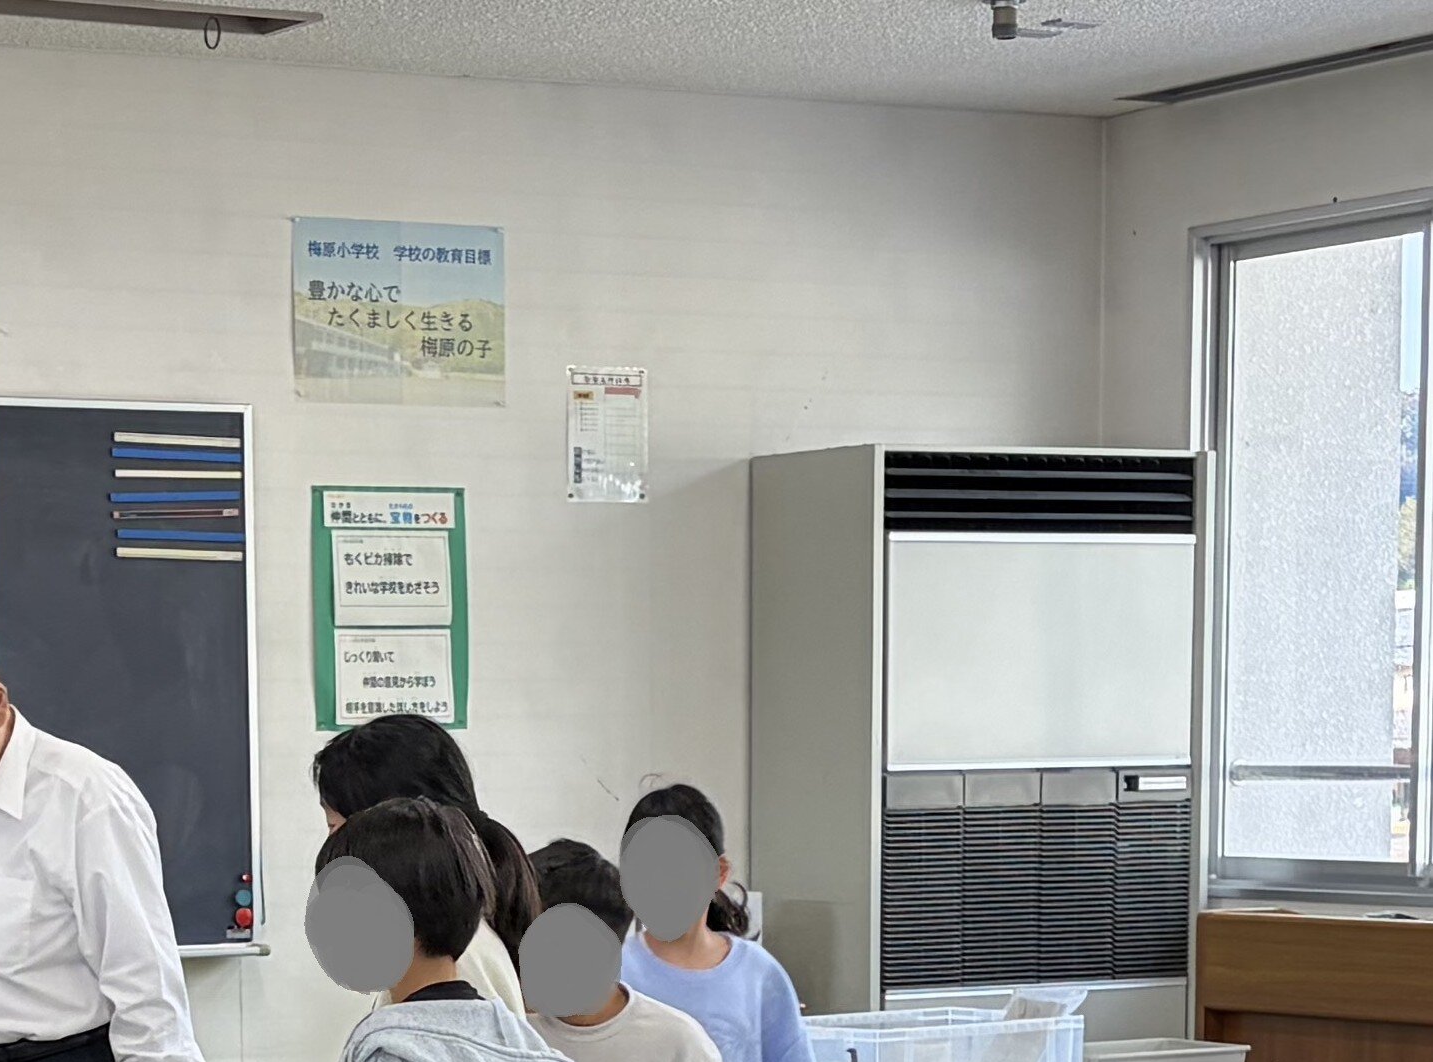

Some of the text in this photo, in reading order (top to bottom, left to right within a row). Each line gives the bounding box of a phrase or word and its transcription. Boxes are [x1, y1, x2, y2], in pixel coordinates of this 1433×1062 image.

[308, 240, 492, 265] 梅原小学校 学校の教育目標
[308, 280, 401, 303] 豊かな心で
[328, 307, 473, 332] たくましく生きる
[420, 336, 492, 358] 梅原の子
[345, 580, 440, 595] きれいな学校をめざそう
